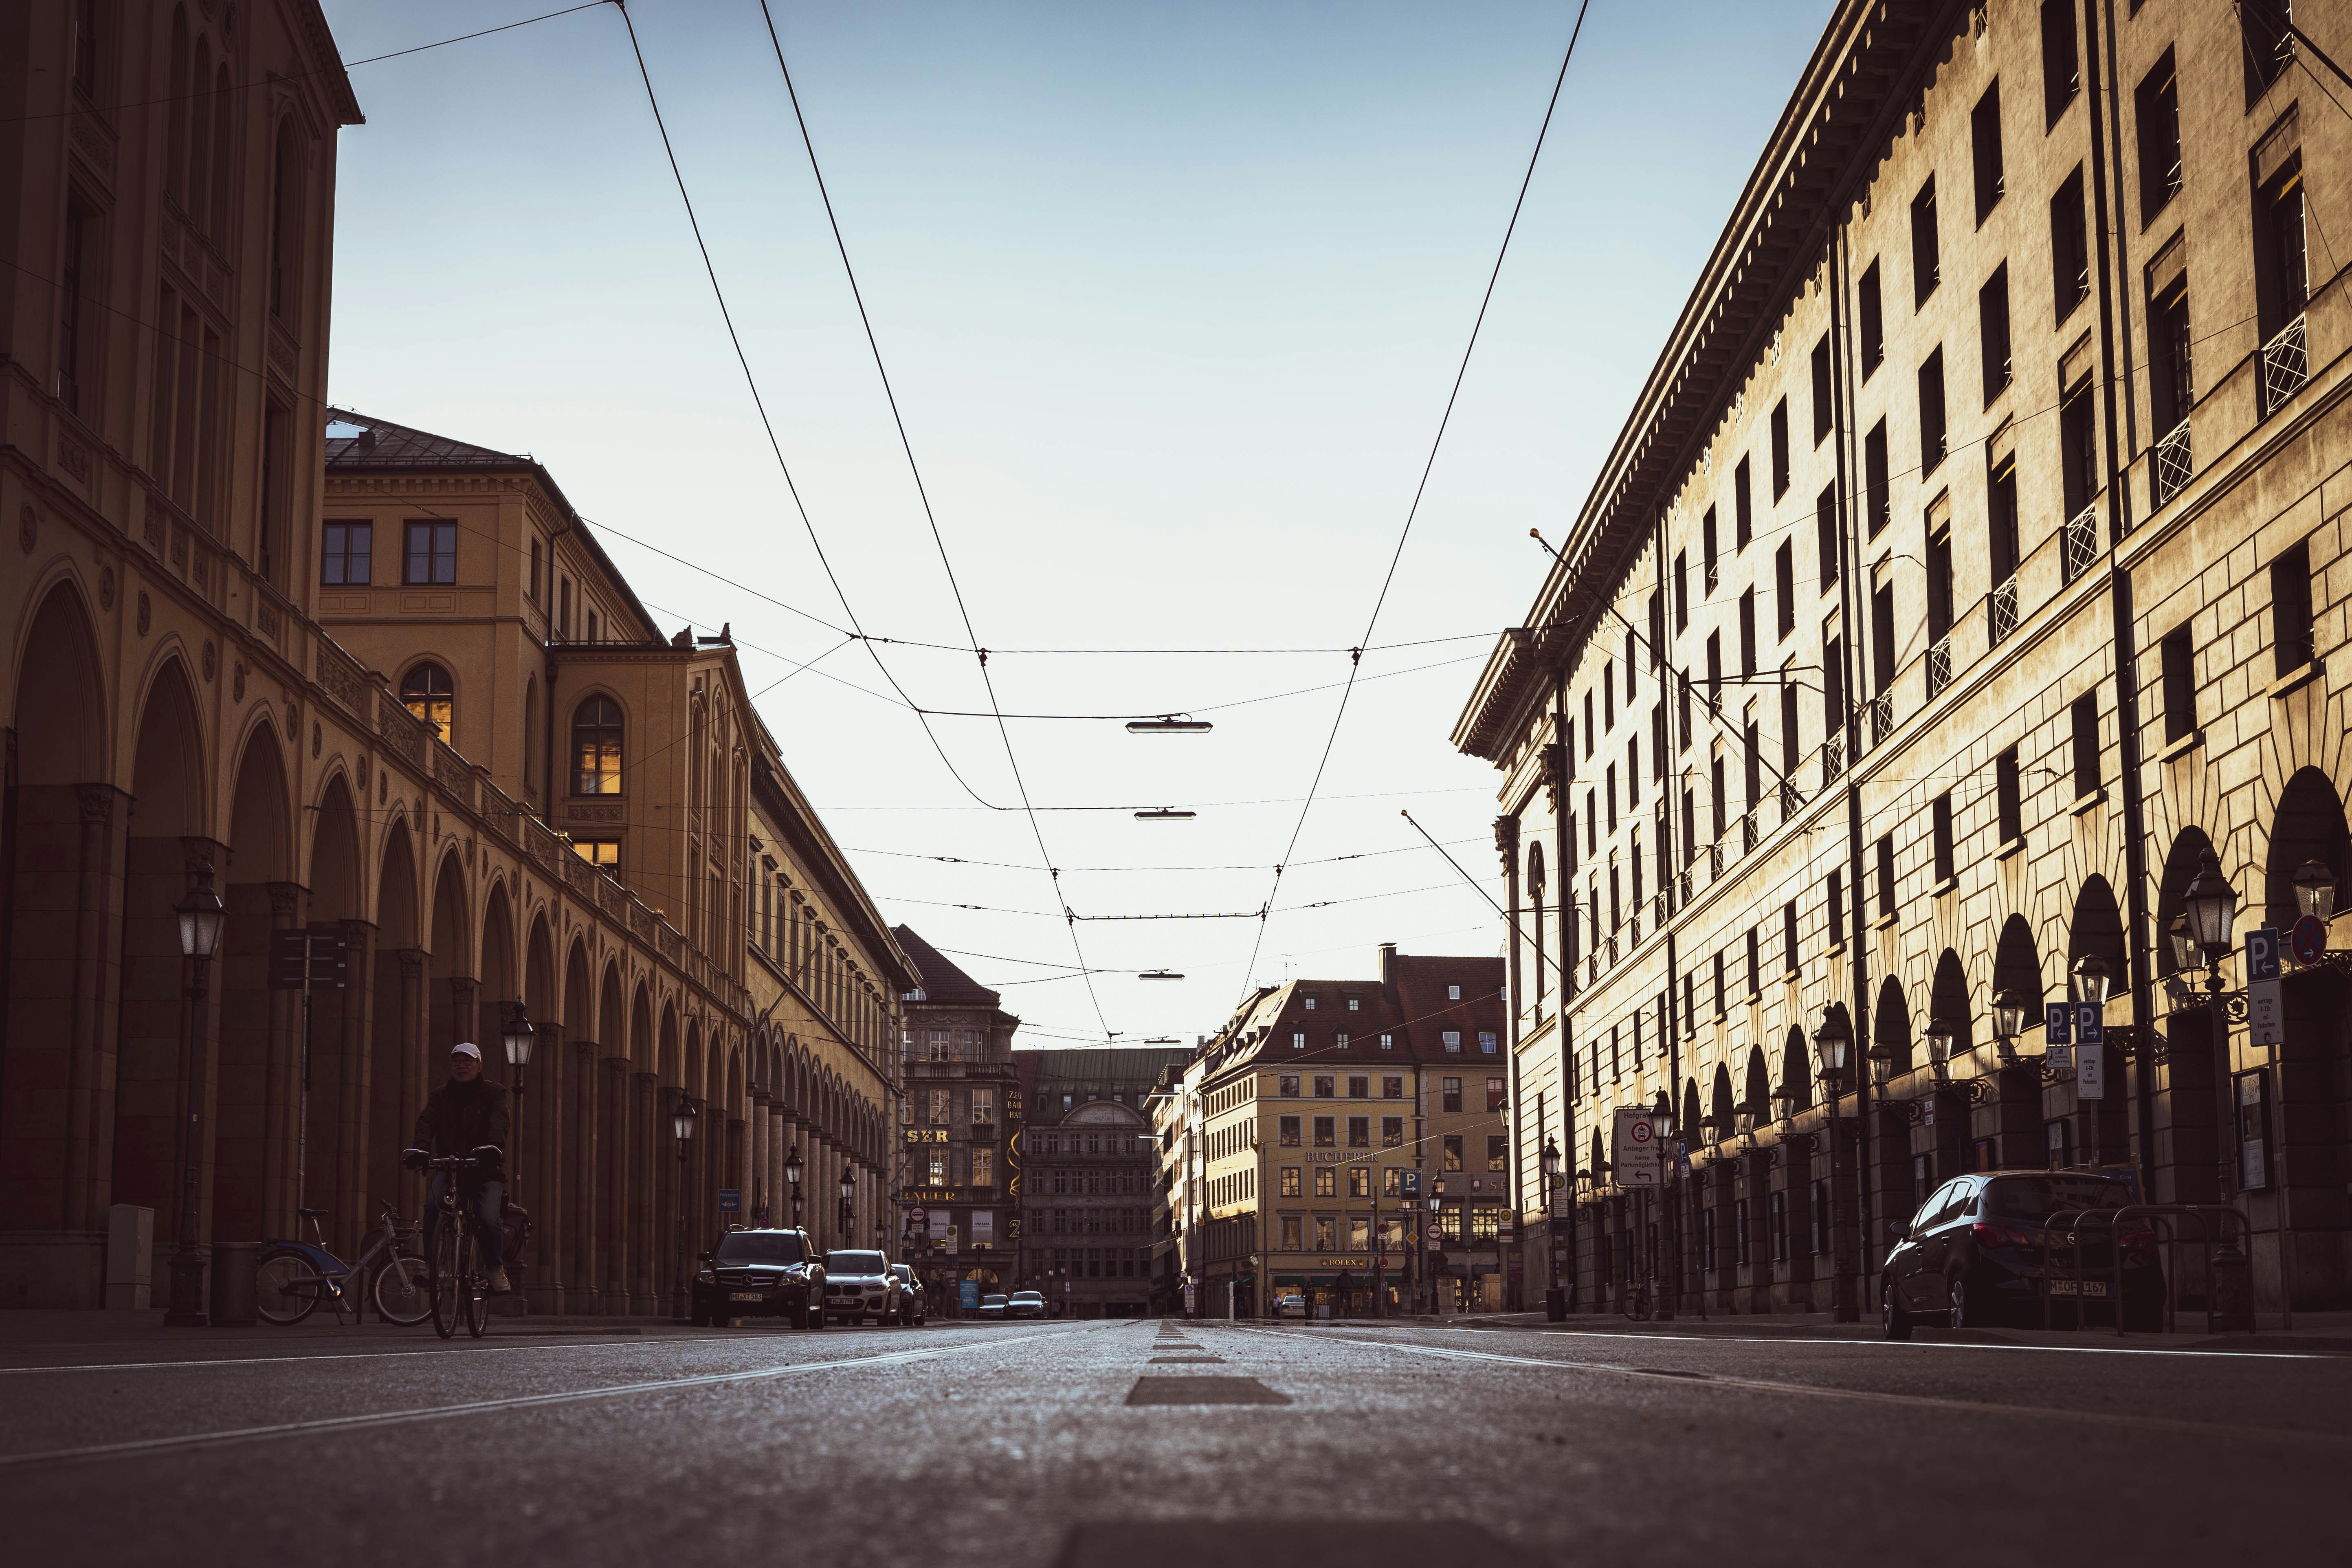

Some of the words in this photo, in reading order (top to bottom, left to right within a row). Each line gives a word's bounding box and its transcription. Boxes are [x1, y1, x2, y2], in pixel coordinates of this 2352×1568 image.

[2251, 937, 2268, 975] P
[2050, 1008, 2063, 1039] P
[2080, 1007, 2094, 1038] P
[902, 1130, 948, 1142] SER
[1306, 1152, 1378, 1162] BUCHERER
[1680, 1143, 1685, 1161] P
[1407, 1174, 1416, 1186] P
